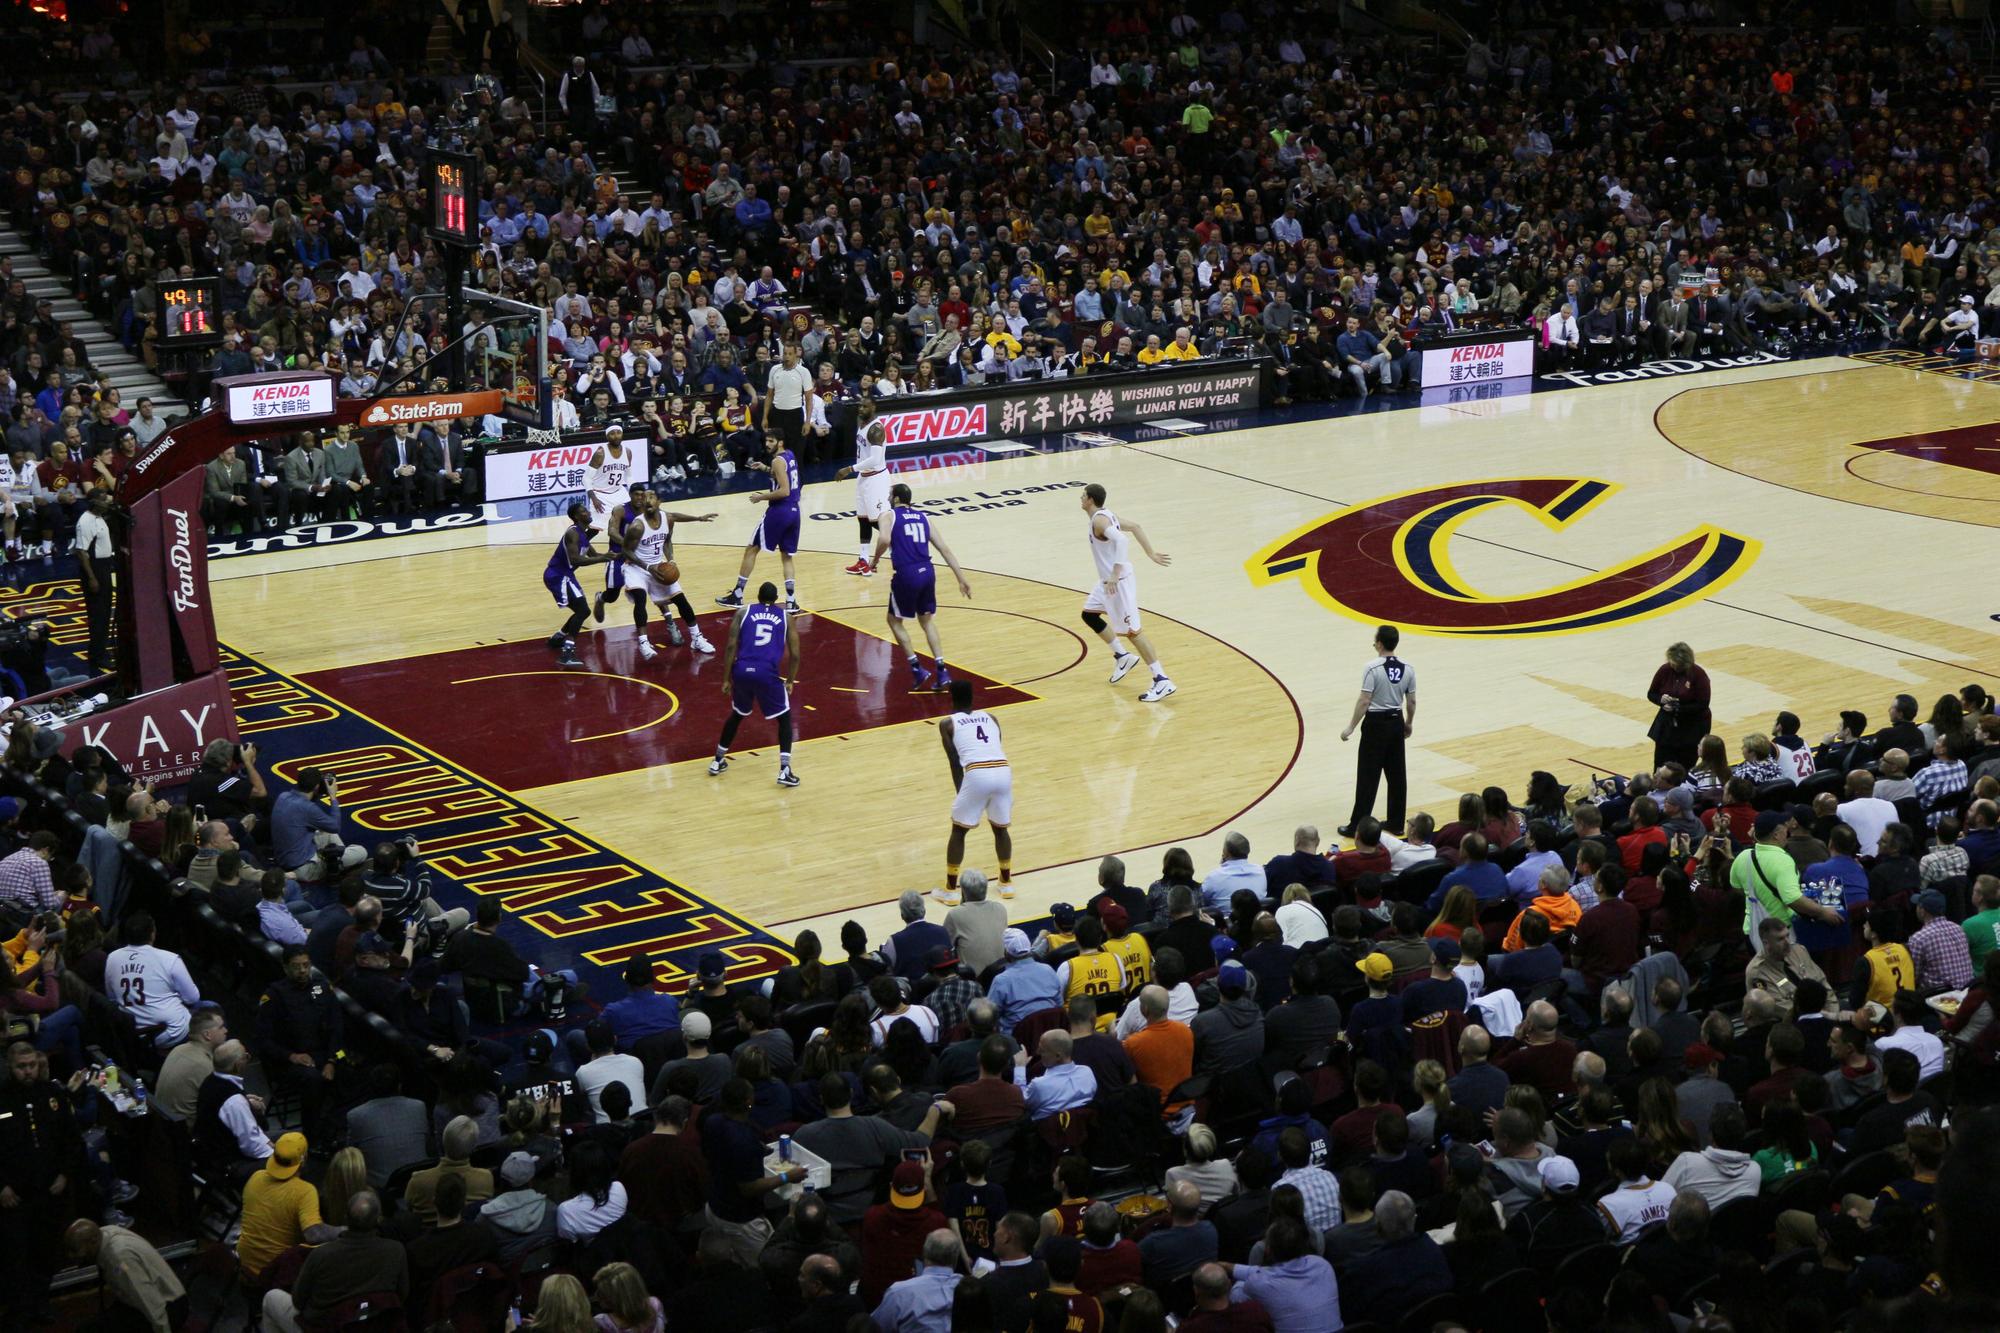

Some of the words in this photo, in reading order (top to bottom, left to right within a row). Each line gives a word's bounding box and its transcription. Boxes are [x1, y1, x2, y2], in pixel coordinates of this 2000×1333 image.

[447, 194, 464, 232] 11
[185, 311, 204, 333] 11
[1451, 344, 1504, 362] KENDA
[1980, 344, 1988, 355] G
[1449, 361, 1503, 381] 建大輪胎
[1540, 350, 1791, 387] FanDuel
[253, 384, 310, 401] KENDA
[1121, 384, 1173, 401] WISHING
[1178, 382, 1202, 395] YOU
[1204, 381, 1212, 392] A
[1215, 376, 1255, 391] HAPPY
[252, 398, 310, 417] 建大輪胎
[1000, 389, 1115, 434] 新年快樂
[1135, 401, 1176, 416] LUNAR
[1179, 398, 1206, 410] NEW
[1208, 392, 1239, 407] YEAR
[879, 404, 986, 446] KENDA
[135, 435, 176, 474] SPALDING
[528, 446, 593, 470] KEND
[528, 468, 586, 493] 建大輪
[608, 473, 622, 486] 52
[974, 480, 1088, 500] Loans
[925, 498, 1028, 518] Arena
[207, 502, 512, 557] anDuel
[641, 533, 667, 547] CAVALIER
[904, 522, 926, 543] 41
[167, 508, 199, 613] FanDuel
[654, 543, 660, 556] 5
[754, 623, 773, 646] 5
[1389, 667, 1401, 681] 52
[83, 705, 211, 761] KAY
[976, 725, 989, 743] 4
[122, 751, 200, 773] WELER
[1793, 752, 1814, 778] 23
[271, 744, 801, 996] CLEVELAND
[121, 964, 145, 975] JAMES
[1123, 952, 1141, 967] JAMES
[1087, 968, 1108, 980] JAMES
[120, 977, 146, 1007] 23
[1641, 1204, 1666, 1223] JAMES
